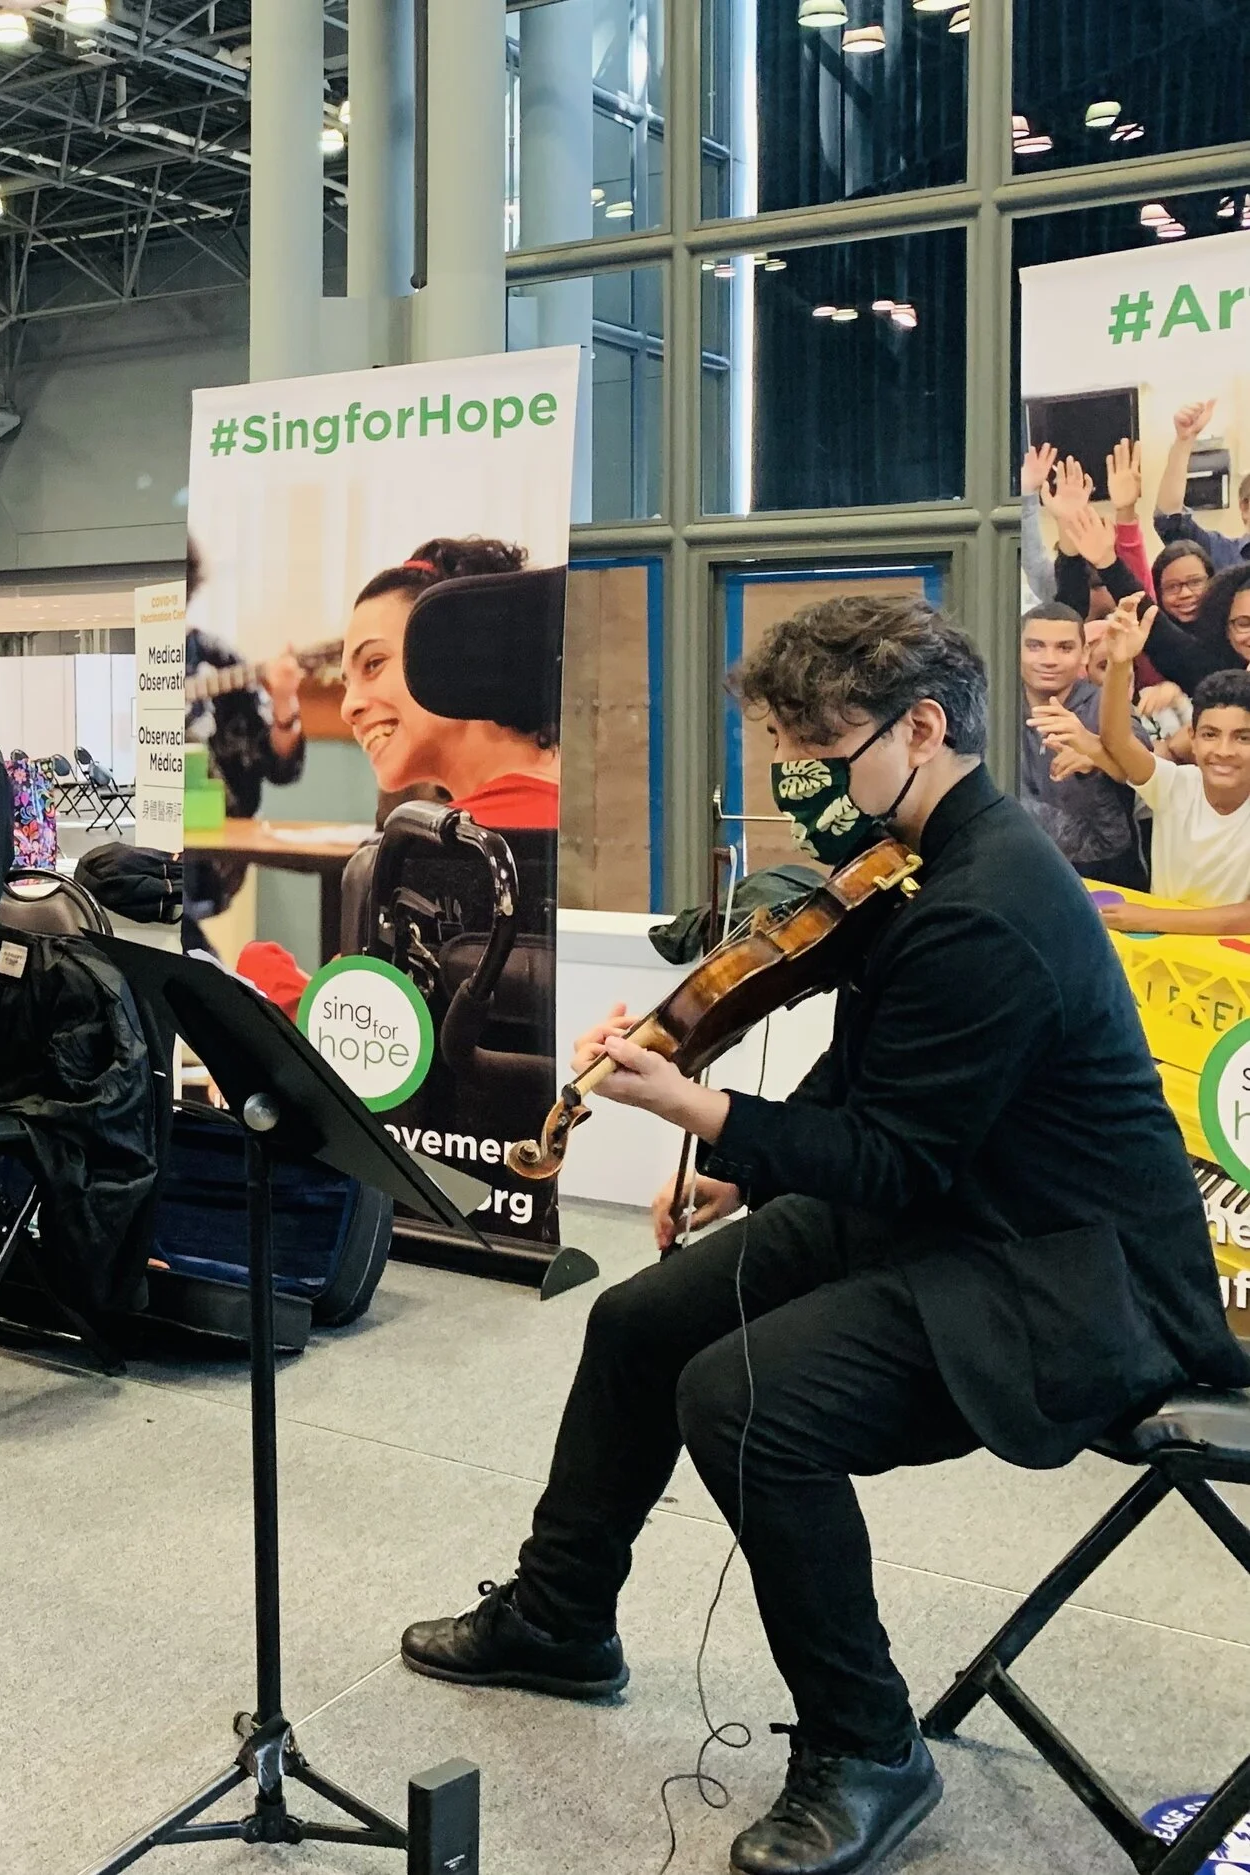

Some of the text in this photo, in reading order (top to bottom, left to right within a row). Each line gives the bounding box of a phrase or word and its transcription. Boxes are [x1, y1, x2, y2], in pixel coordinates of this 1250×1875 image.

[1108, 283, 1250, 344] #Ar
[210, 392, 558, 457] #SingforHope
[148, 644, 184, 665] Medical
[138, 671, 185, 692] Observati
[149, 752, 183, 773] Médica
[323, 996, 398, 1040] sing for
[318, 1026, 409, 1070] hope
[1153, 1809, 1194, 1847] EASE
